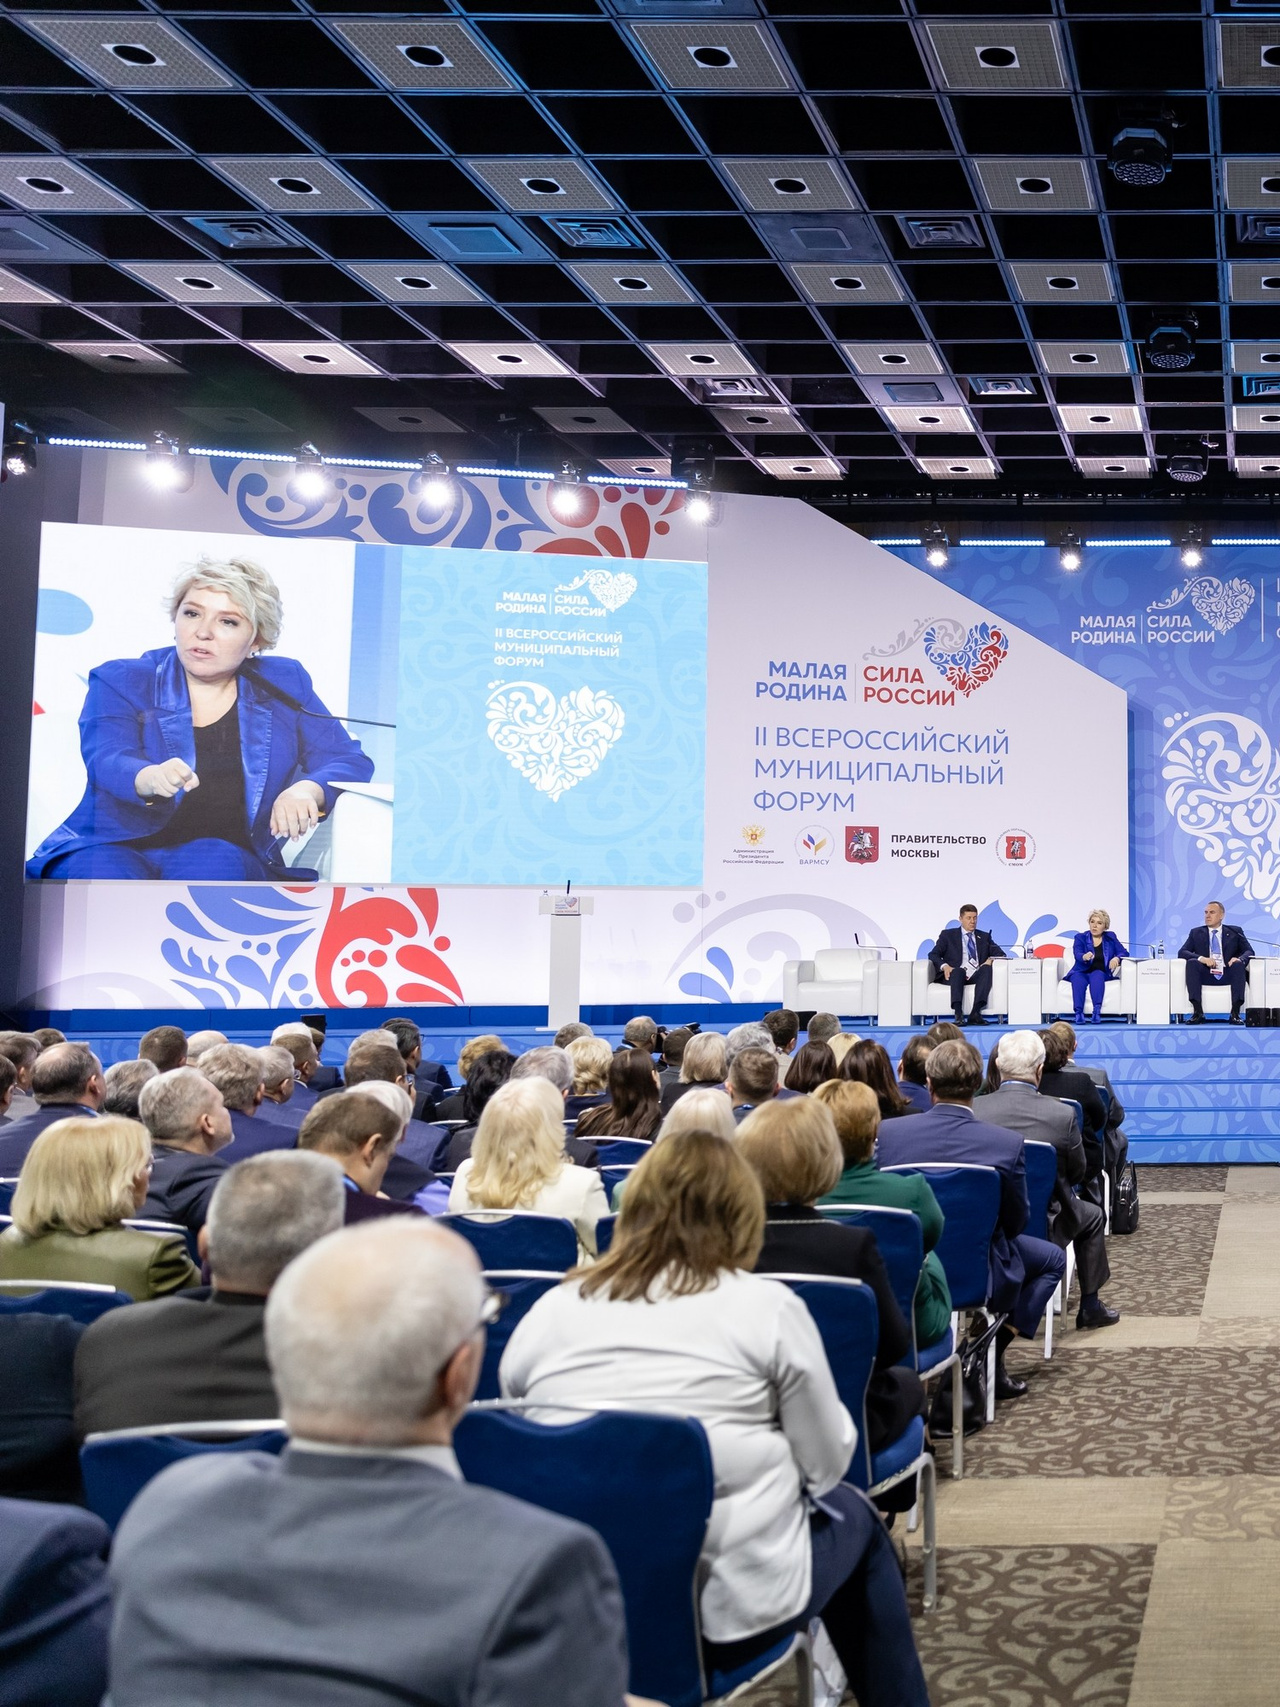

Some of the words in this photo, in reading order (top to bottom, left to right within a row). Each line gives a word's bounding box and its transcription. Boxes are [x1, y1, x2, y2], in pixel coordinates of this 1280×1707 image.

[502, 591, 546, 603] МАЛАЯ
[554, 594, 590, 605] СИЛА
[495, 602, 546, 614] РОДИНА
[554, 605, 606, 617] РОССИИ
[1080, 615, 1136, 628] МАЛАЯ
[1147, 615, 1192, 628] СИЛА
[506, 628, 623, 644] ВСЕРОССИЙСКИЙ
[1071, 631, 1136, 645] РОДИНА
[1147, 630, 1215, 644] РОССИИ
[494, 642, 620, 657] МУНИЦИПАЛЬНЫЙ
[494, 656, 544, 667] ФОРУМ
[769, 661, 847, 680] МАЛАЯ
[863, 665, 925, 684] СИЛА
[756, 681, 847, 702] РОДИНА
[864, 686, 955, 706] РОССИИ
[755, 726, 767, 746] II
[776, 726, 1009, 754] ВСЕРОССИЙСКИЙ
[755, 759, 1004, 785] МУНИЦИПАЛЬНЫЙ
[753, 790, 854, 812] ФОРУМ
[891, 834, 987, 846] ПРАВИТЕЛЬСТВО
[891, 848, 940, 859] МОСКВЫ
